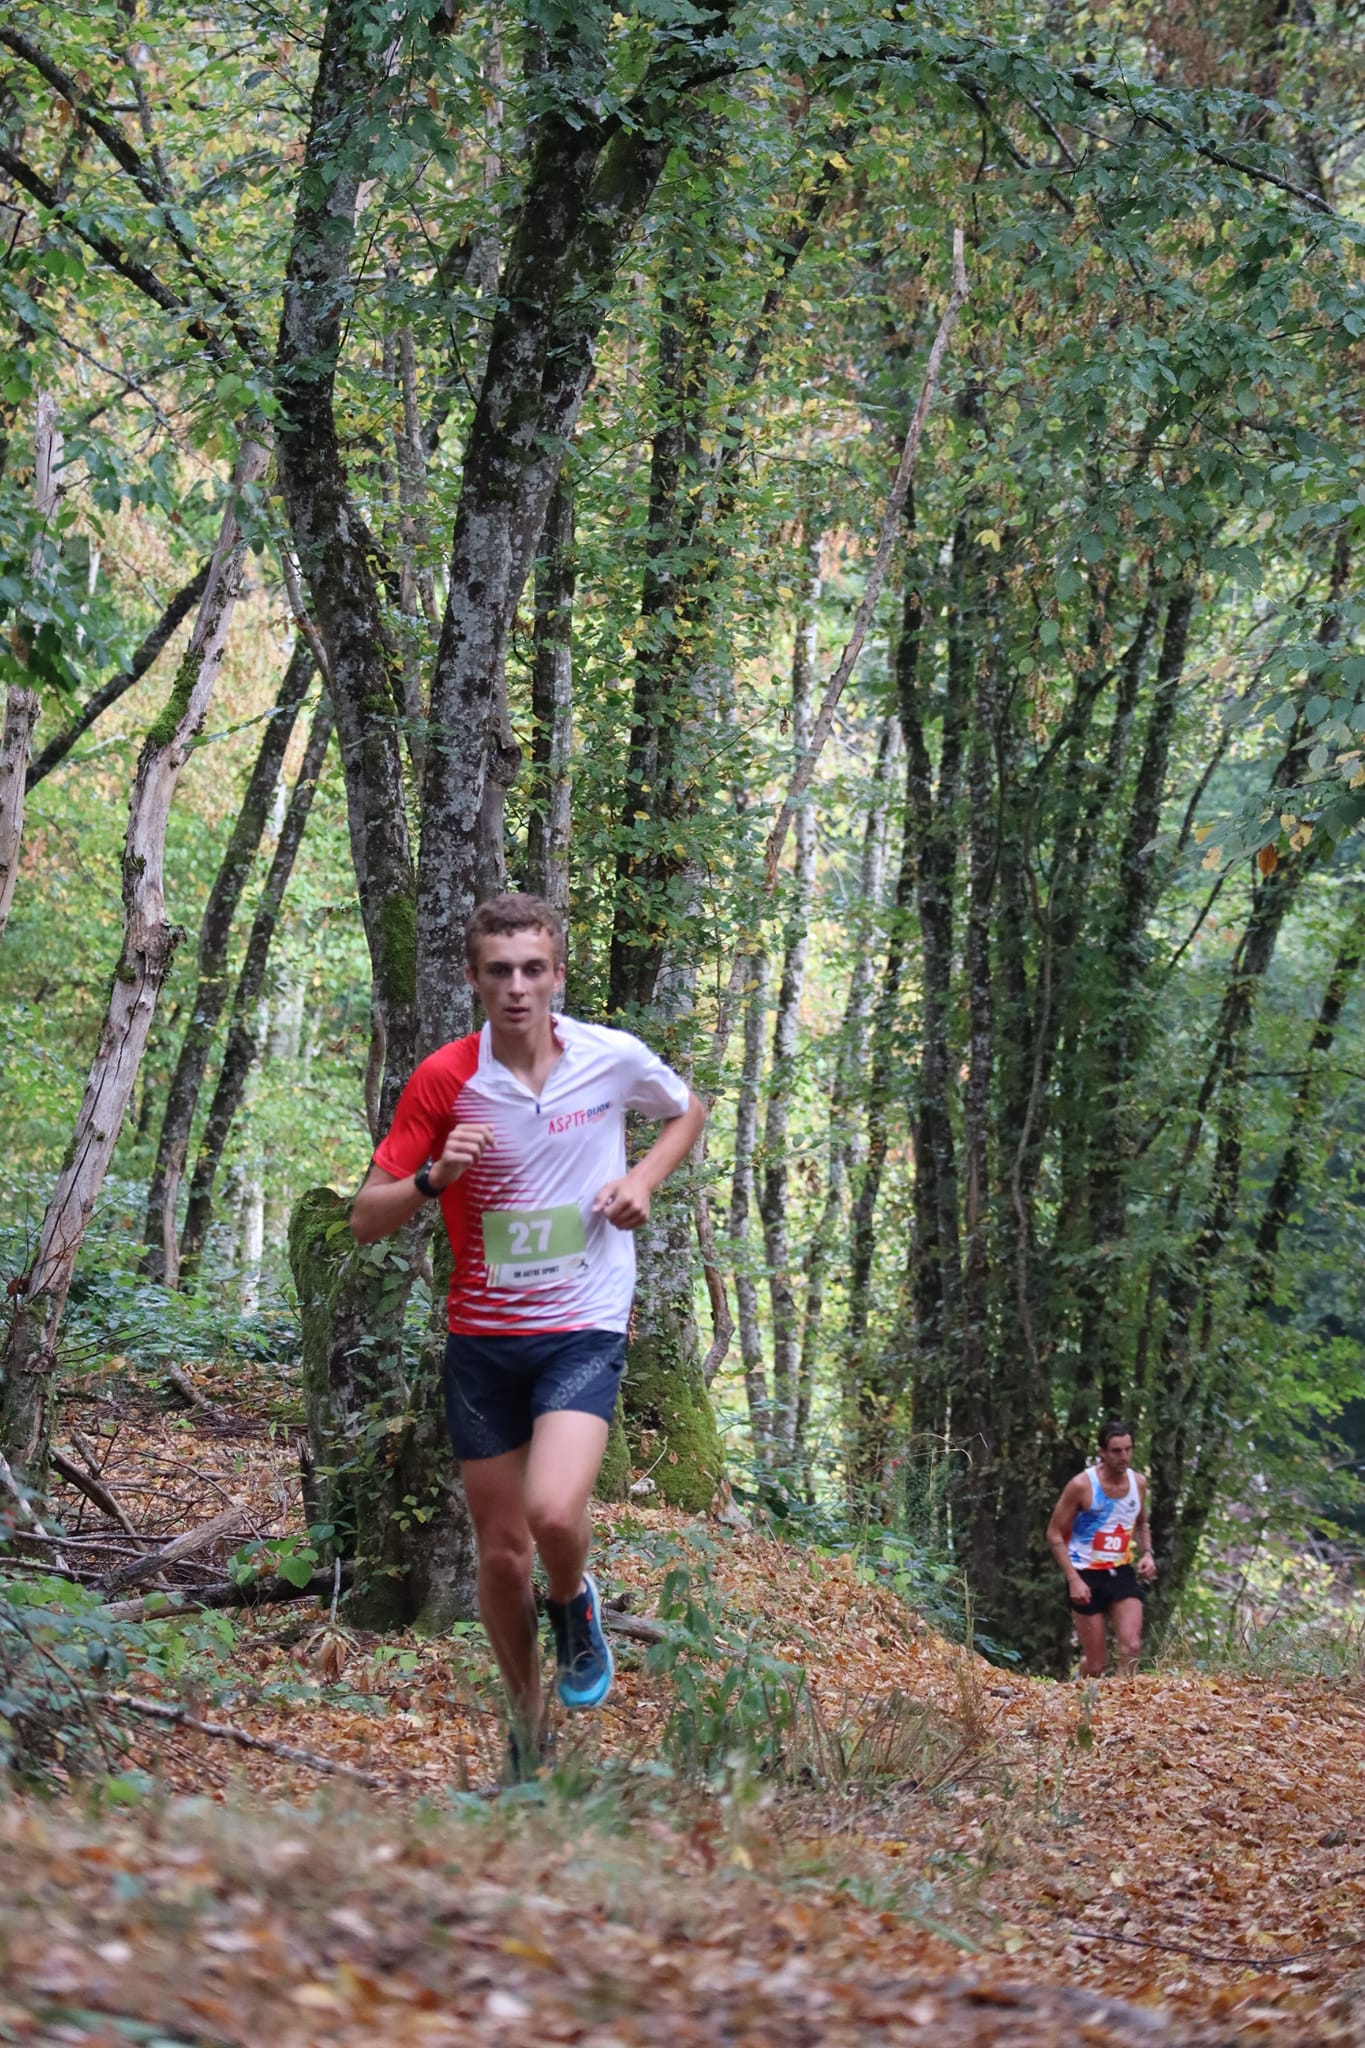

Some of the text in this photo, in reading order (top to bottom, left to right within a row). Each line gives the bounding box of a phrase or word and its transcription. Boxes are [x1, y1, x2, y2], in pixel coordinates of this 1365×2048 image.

[548, 1110, 586, 1136] ASPTT
[586, 1101, 610, 1118] DIJON
[508, 1219, 553, 1256] 27
[1104, 1536, 1122, 1551] 20
